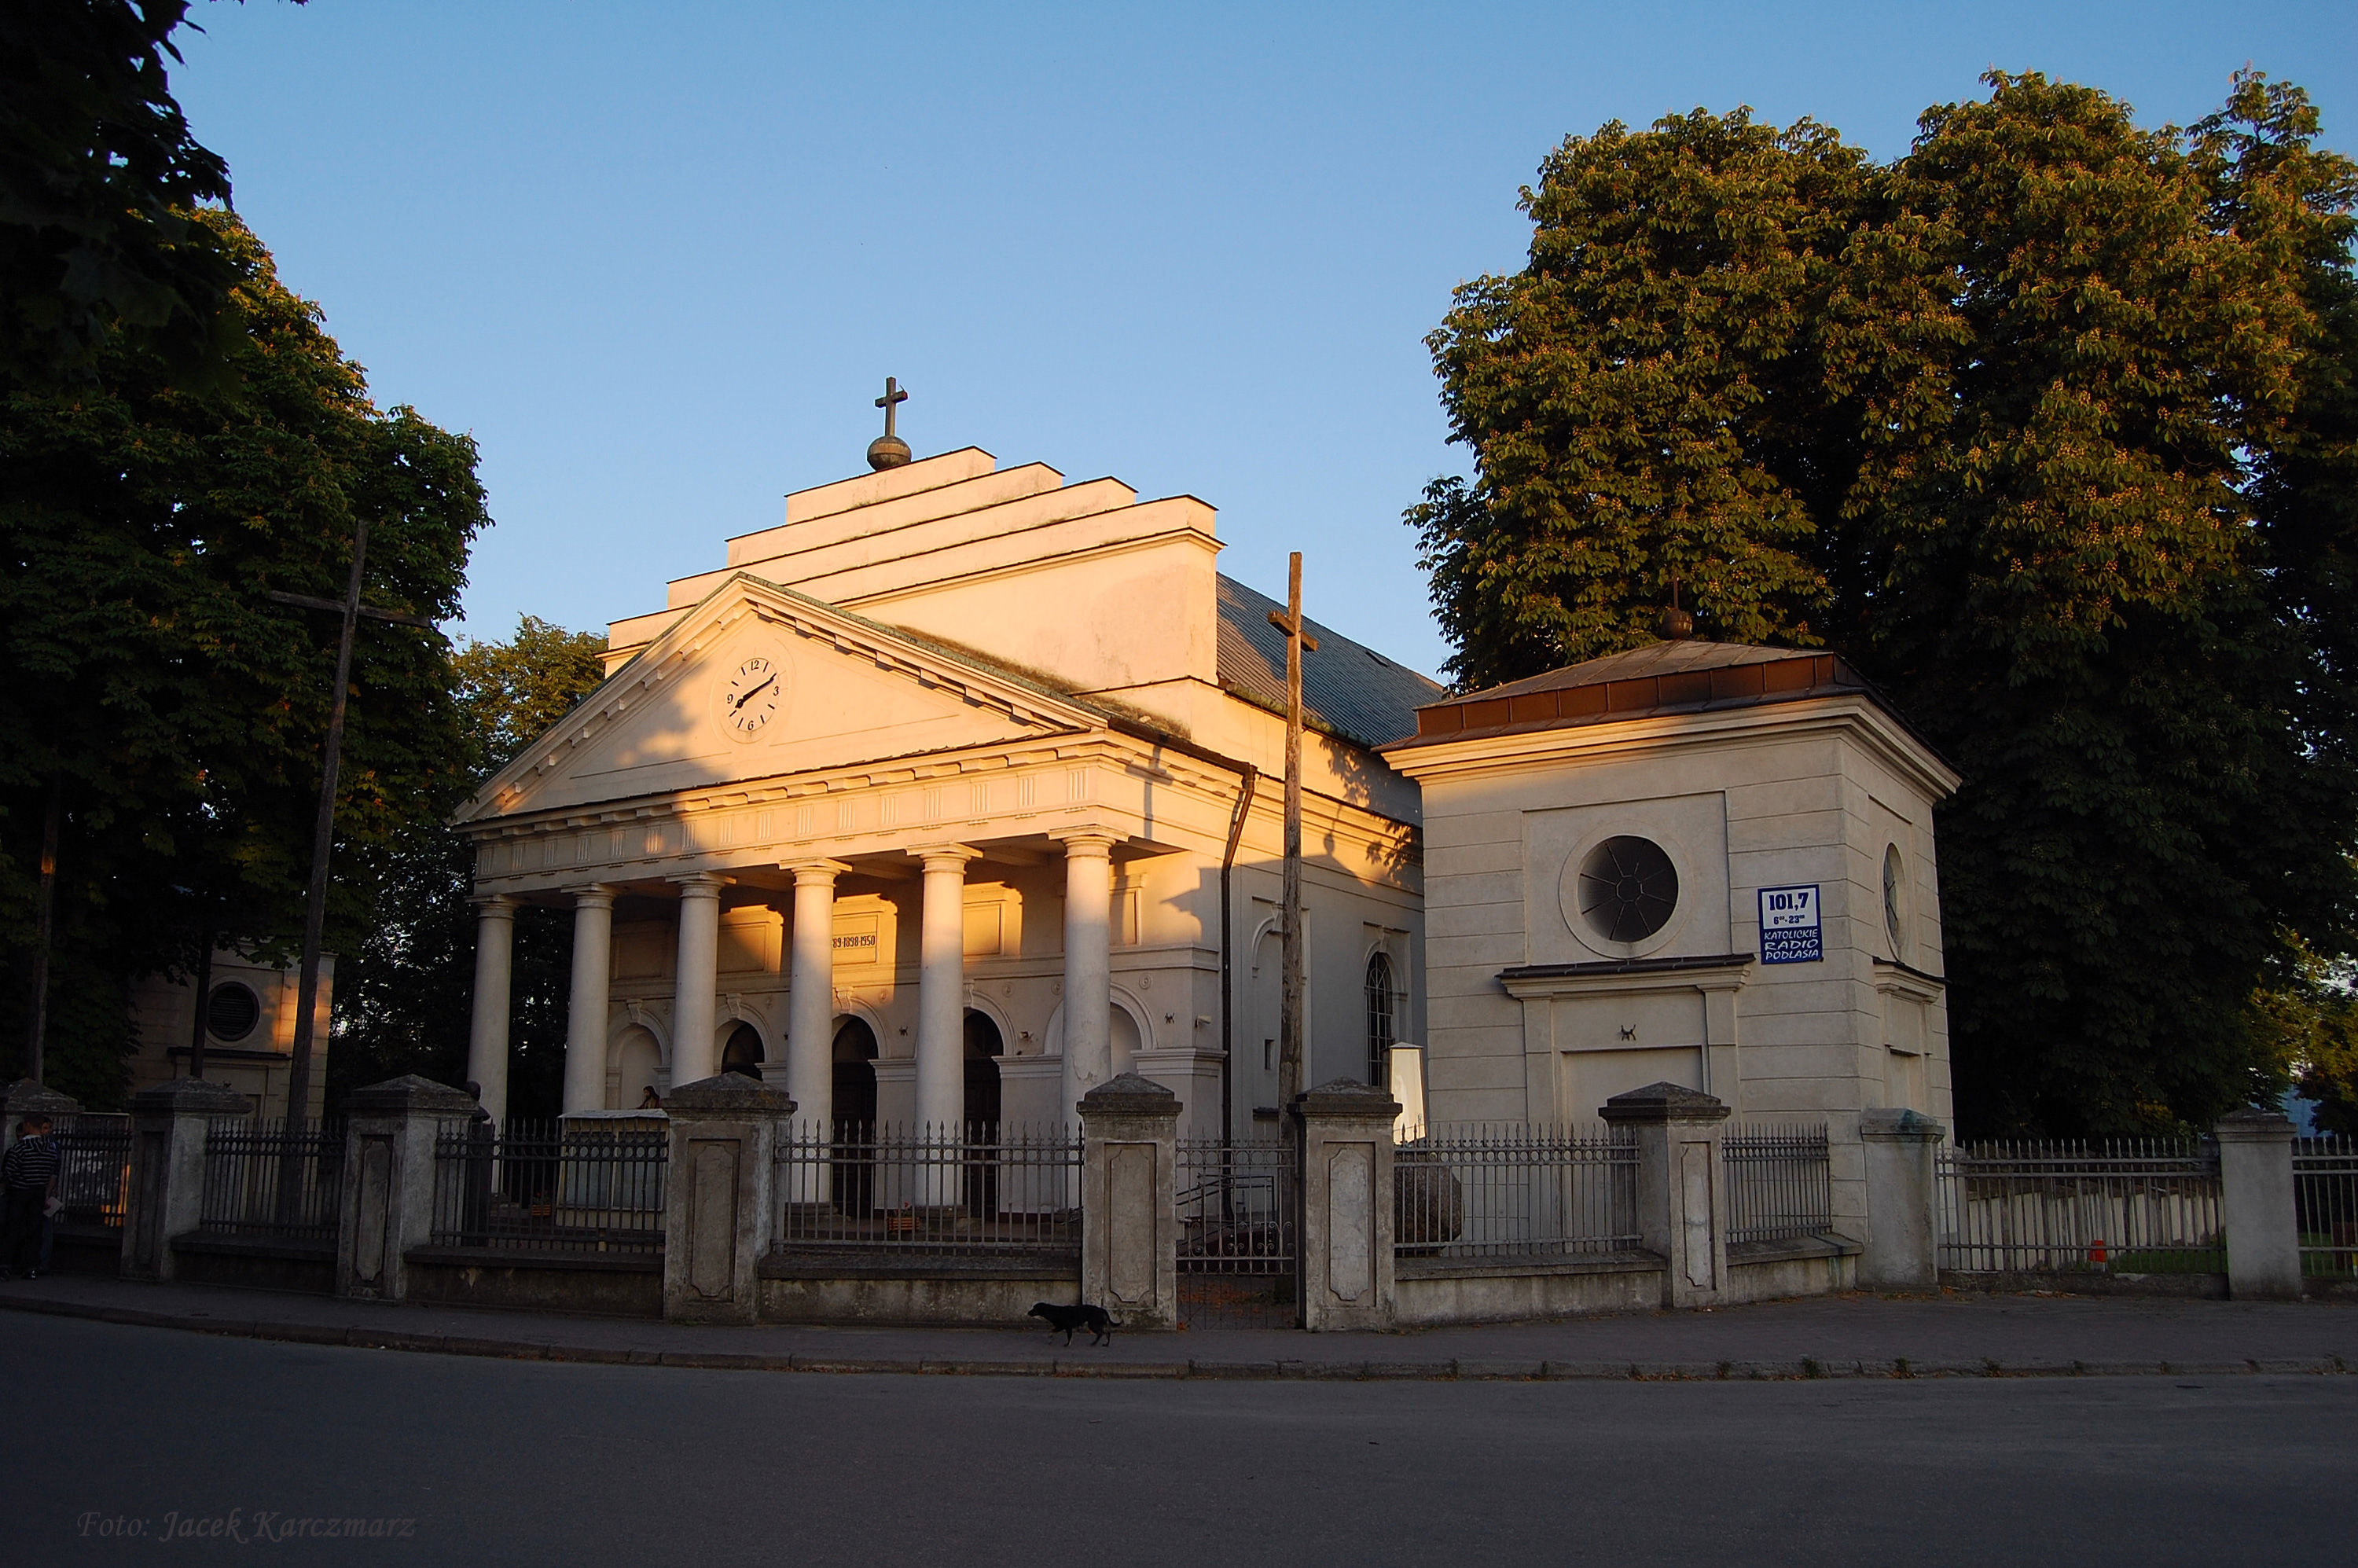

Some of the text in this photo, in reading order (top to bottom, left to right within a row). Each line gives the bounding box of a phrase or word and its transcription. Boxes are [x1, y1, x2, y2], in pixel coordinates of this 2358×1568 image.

[751, 659, 759, 670] 12
[773, 686, 779, 696] 3
[727, 694, 733, 703] 9
[747, 721, 754, 731] 6
[1768, 892, 1809, 911] 101,7
[1765, 928, 1818, 940] KATOLICKIE
[1765, 939, 1819, 950] RADIO
[1765, 949, 1819, 960] PODLASIA
